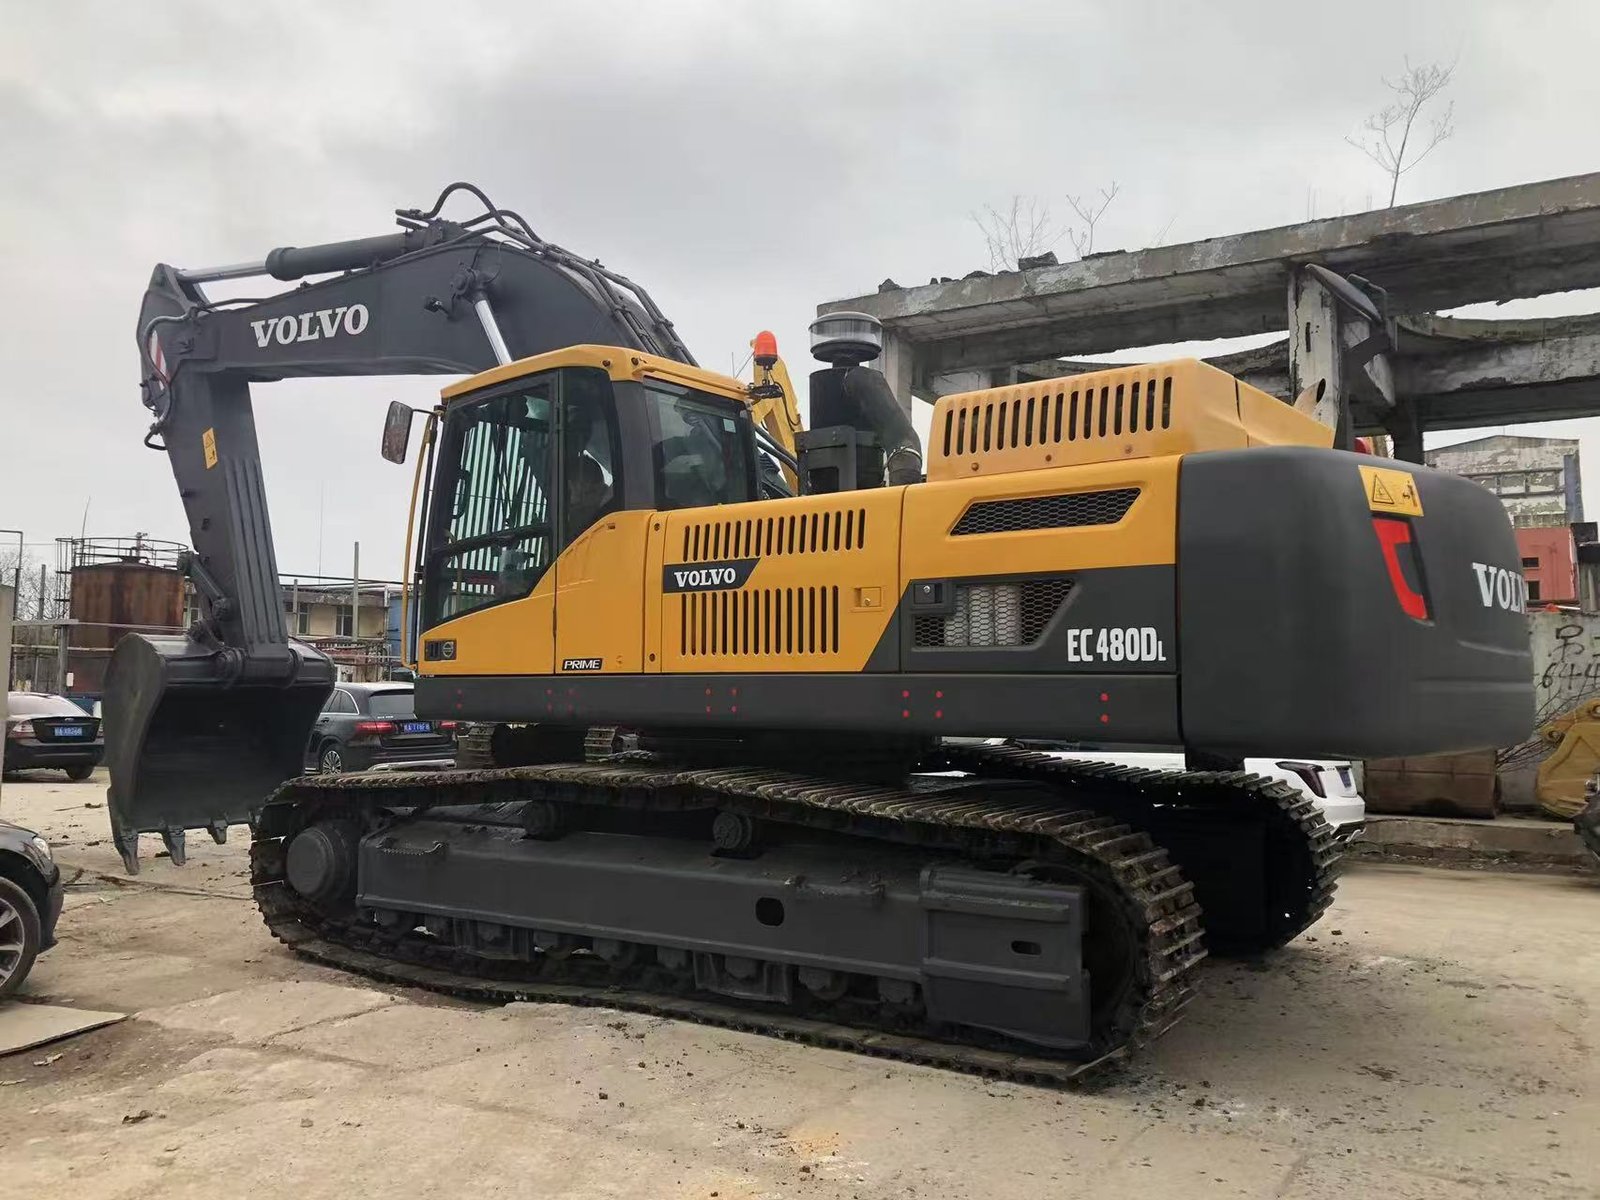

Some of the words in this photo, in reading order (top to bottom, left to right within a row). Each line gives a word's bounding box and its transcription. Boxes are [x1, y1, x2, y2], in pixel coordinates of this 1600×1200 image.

[250, 303, 369, 348] VOLVO
[673, 567, 736, 588] VOLVO
[1472, 562, 1526, 615] VOLV
[563, 659, 601, 670] PRIME
